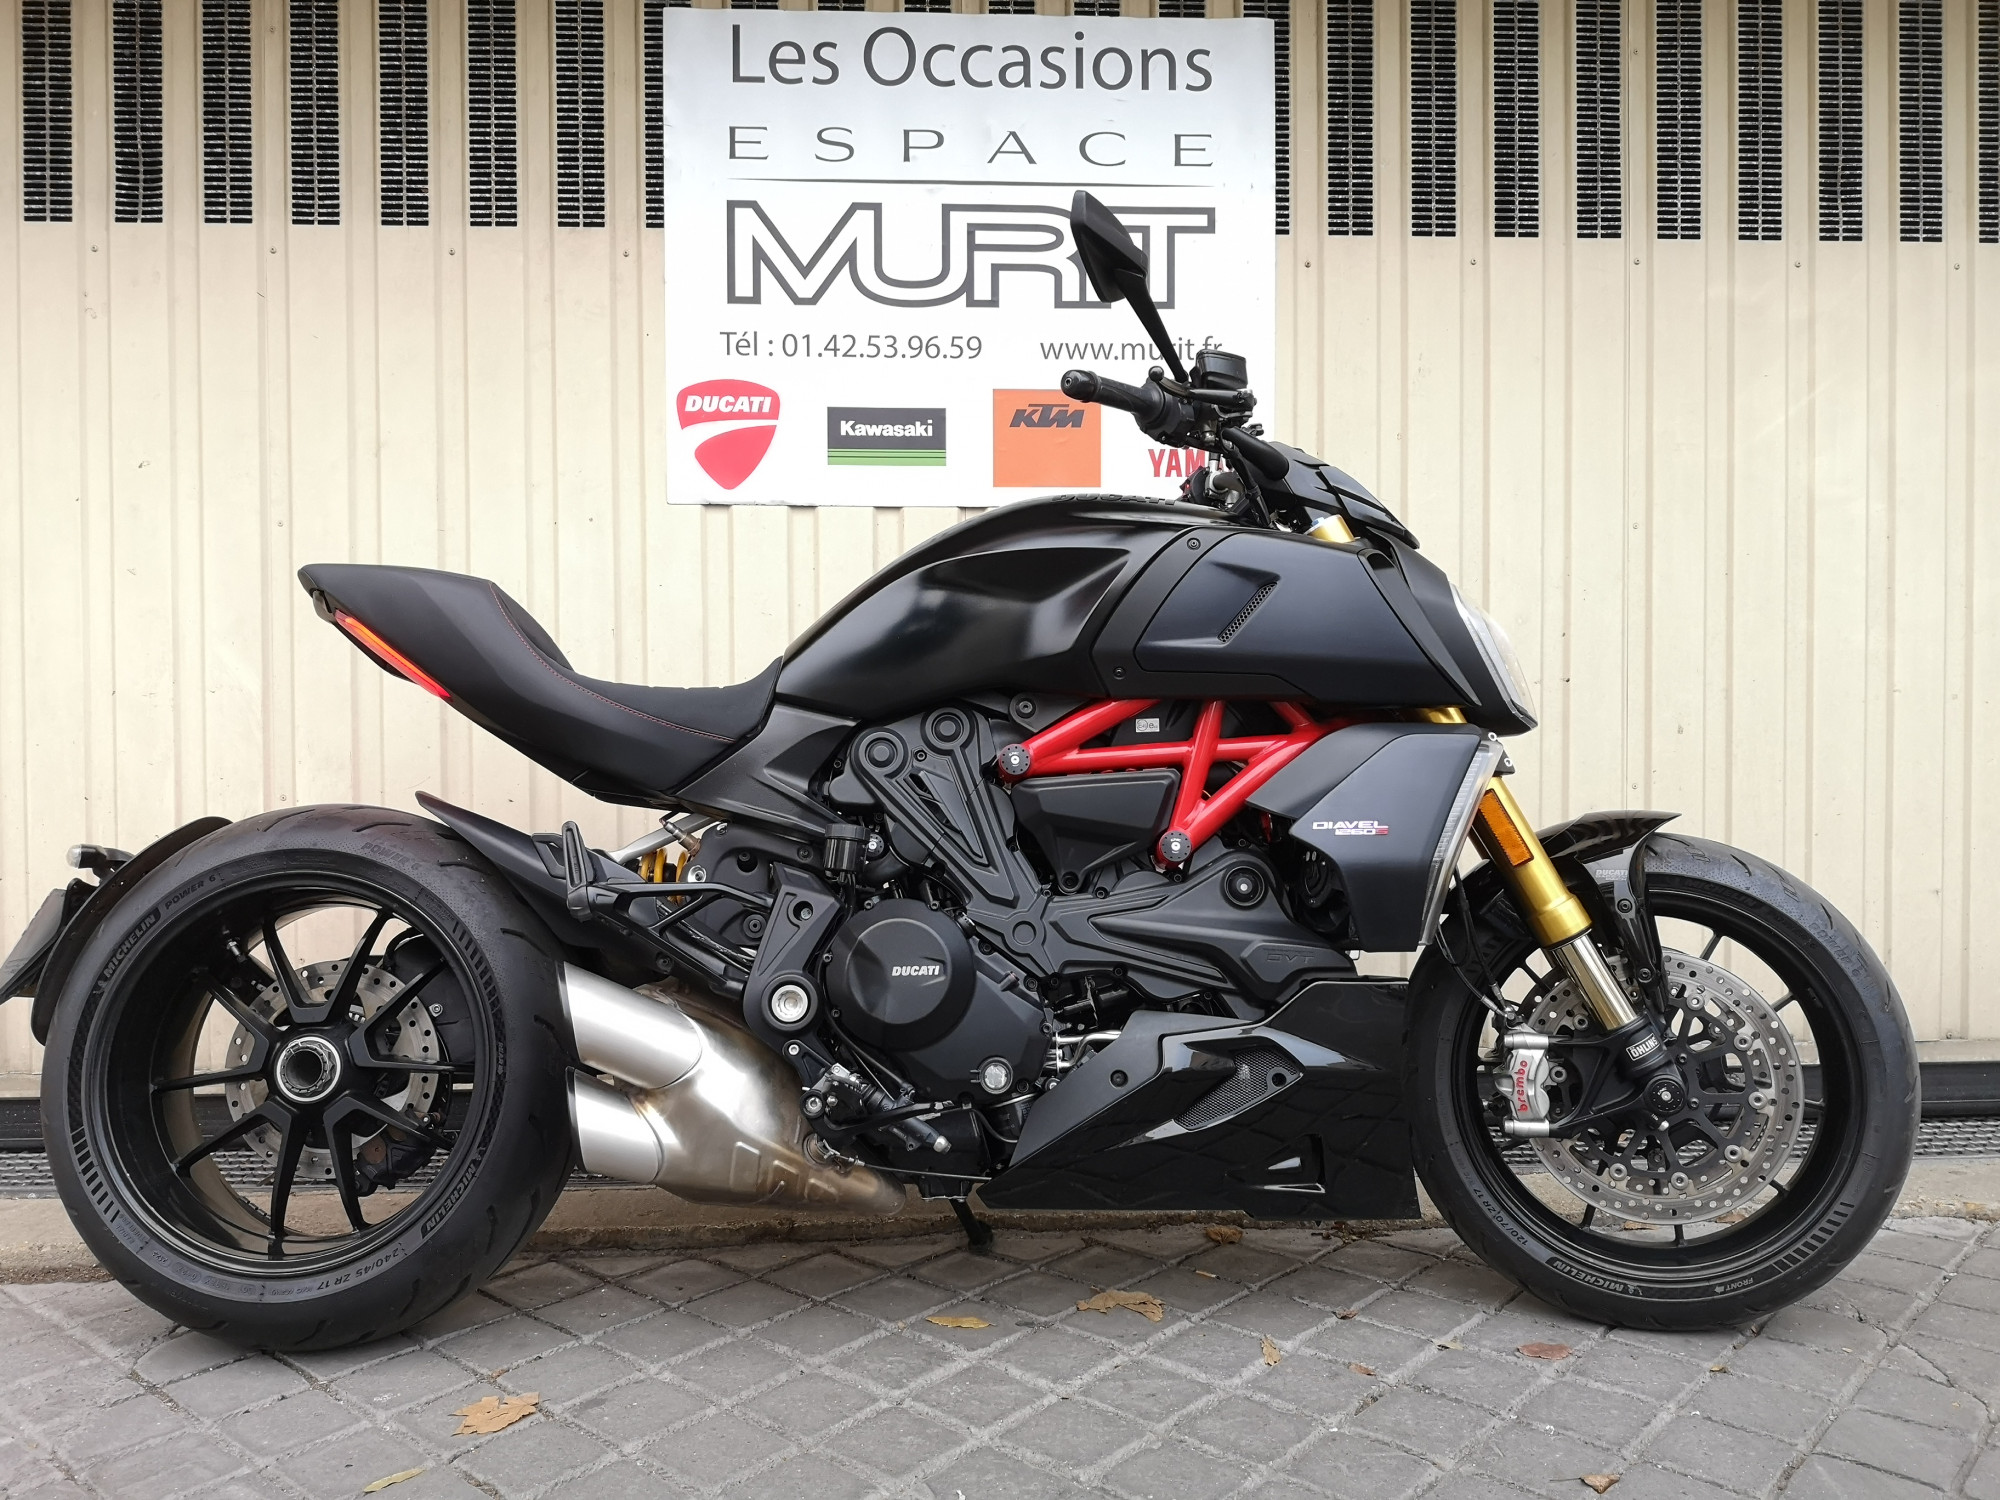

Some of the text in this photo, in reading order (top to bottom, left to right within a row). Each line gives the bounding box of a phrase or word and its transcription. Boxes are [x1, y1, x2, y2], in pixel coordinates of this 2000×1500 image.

[733, 24, 1213, 92] Les Occasions
[728, 126, 1214, 167] ESPACE
[727, 200, 1215, 309] MURT
[720, 331, 758, 356] Tél
[782, 333, 982, 359] 01.42.53.96.59
[1040, 336, 1222, 360] www.muitfr
[685, 395, 772, 413] DUCATI
[1009, 404, 1086, 428] KTM
[840, 419, 933, 437] Kawasaki
[1050, 494, 1175, 506] DUCATI
[1312, 820, 1389, 830] DIAVEL
[1595, 868, 1628, 876] DUCATI
[103, 913, 157, 978] MICHELIN
[165, 880, 204, 910] POWER
[1267, 953, 1315, 964] DVT
[891, 965, 940, 977] DUCATI
[1630, 1036, 1659, 1058] ÖHLINS
[1514, 1060, 1528, 1112] brembo
[425, 1159, 477, 1231] MICHELIN
[1473, 1188, 1528, 1246] 120/70 ZR 17
[355, 1250, 400, 1278] 240/45
[317, 1280, 332, 1291] 17
[334, 1272, 351, 1285] ZR
[1554, 1260, 1624, 1293] MICHELIN
[1725, 1277, 1754, 1292] FRONT
